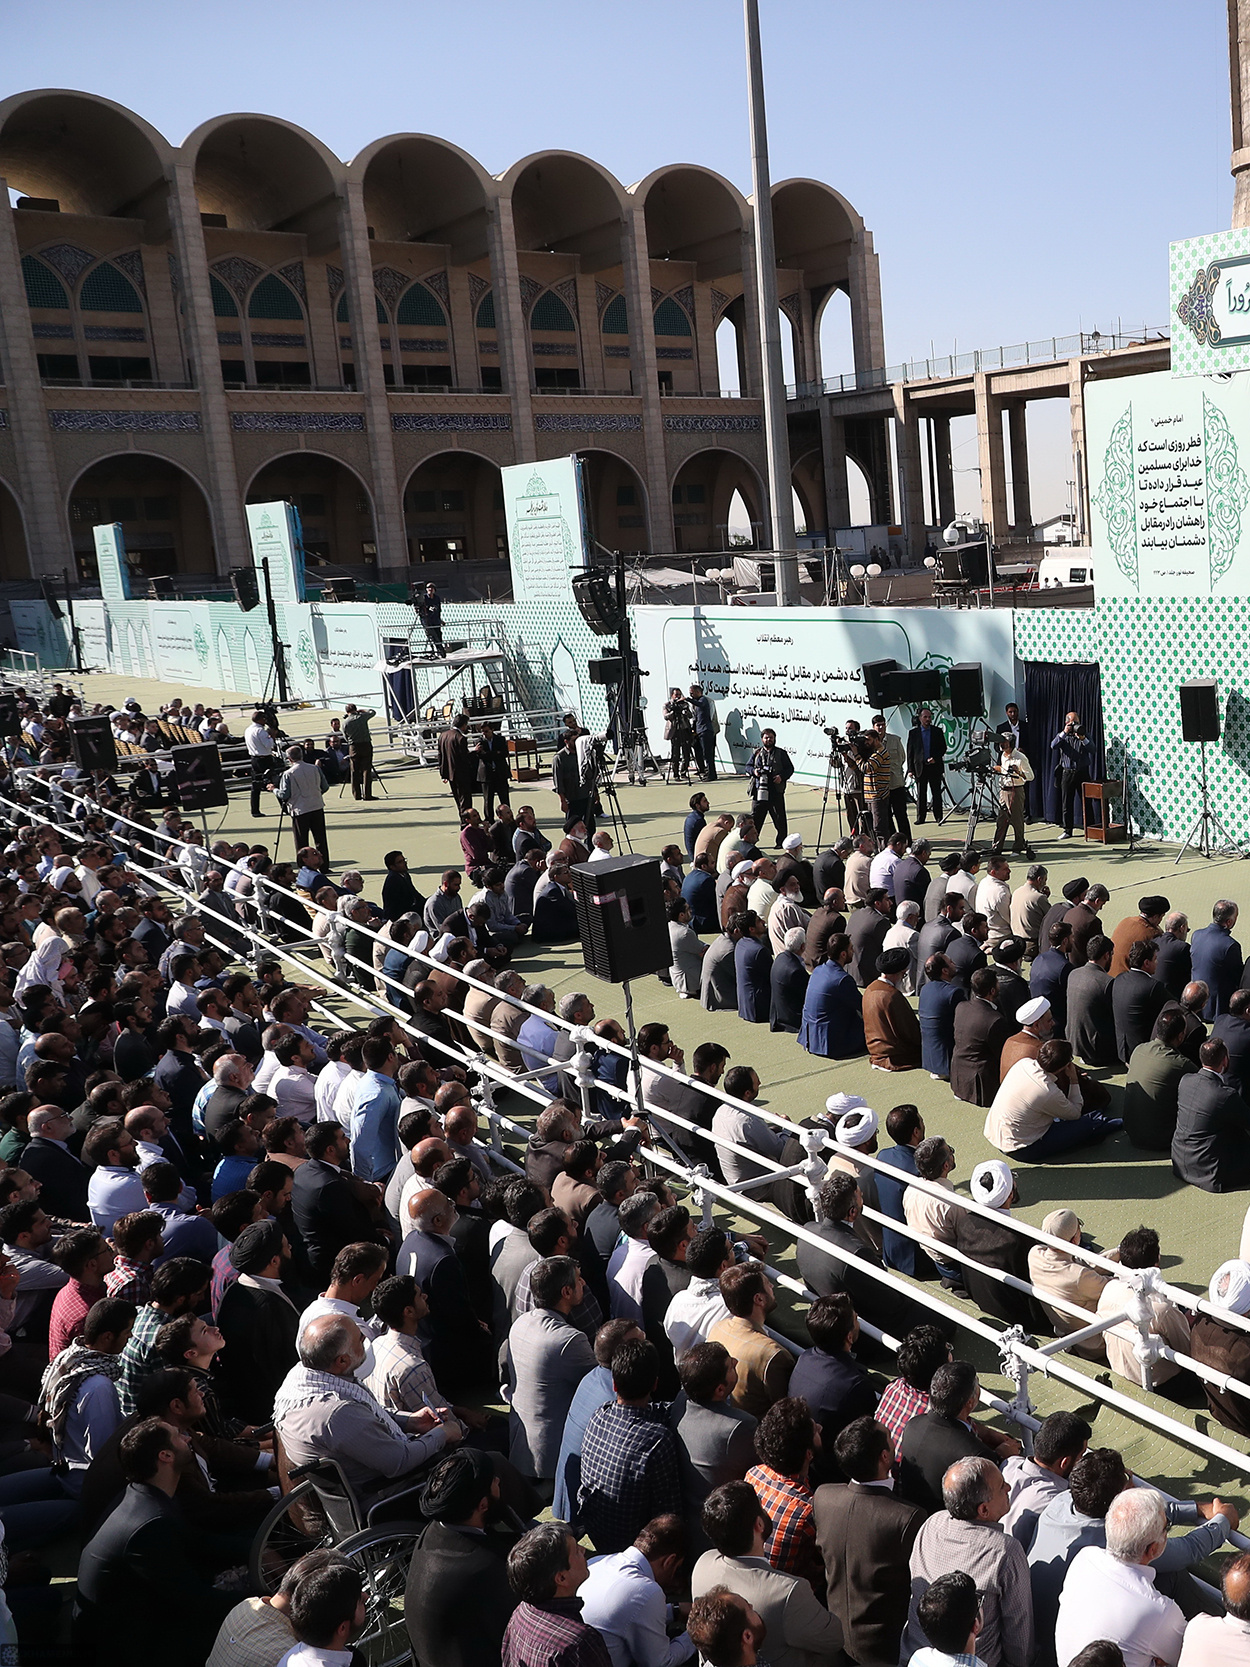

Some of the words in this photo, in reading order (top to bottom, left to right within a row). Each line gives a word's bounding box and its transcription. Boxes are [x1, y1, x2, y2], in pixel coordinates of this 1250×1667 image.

[1172, 414, 1184, 427] امام
[1137, 441, 1148, 452] که
[1149, 439, 1167, 451] است
[1168, 440, 1187, 452] روزی
[1187, 434, 1202, 451] فطر
[1138, 459, 1172, 474] مسلمین
[1172, 458, 1188, 471] برای
[1187, 456, 1202, 469] خدا
[1138, 479, 1148, 490] تا
[1148, 478, 1164, 490] داده
[1165, 475, 1182, 492] قرار
[1182, 479, 1203, 491] عید
[1139, 498, 1158, 512] خود
[1159, 496, 1192, 513] اجتماع
[1194, 495, 1204, 509] با
[1141, 517, 1162, 531] مقابل
[1176, 515, 1205, 529] راهشان
[1141, 536, 1168, 550] بیابند
[1169, 534, 1206, 549] دشمنان
[688, 661, 700, 675] هم
[700, 660, 707, 675] با
[707, 662, 721, 673] همه
[741, 664, 767, 679] ایستاده
[768, 664, 788, 681] کشور
[790, 665, 811, 682] مقابل
[849, 667, 861, 682] که
[812, 670, 820, 683] در
[822, 667, 848, 683] دشمن
[714, 683, 730, 697] جهت
[731, 683, 742, 698] یک
[742, 687, 749, 698] در
[817, 692, 830, 706] هم
[830, 692, 852, 704] دست
[853, 693, 862, 708] به
[740, 704, 758, 719] کشور
[758, 706, 780, 719] عظمت
[780, 711, 785, 723] و
[786, 707, 812, 723] استقلال
[812, 708, 826, 728] برای
